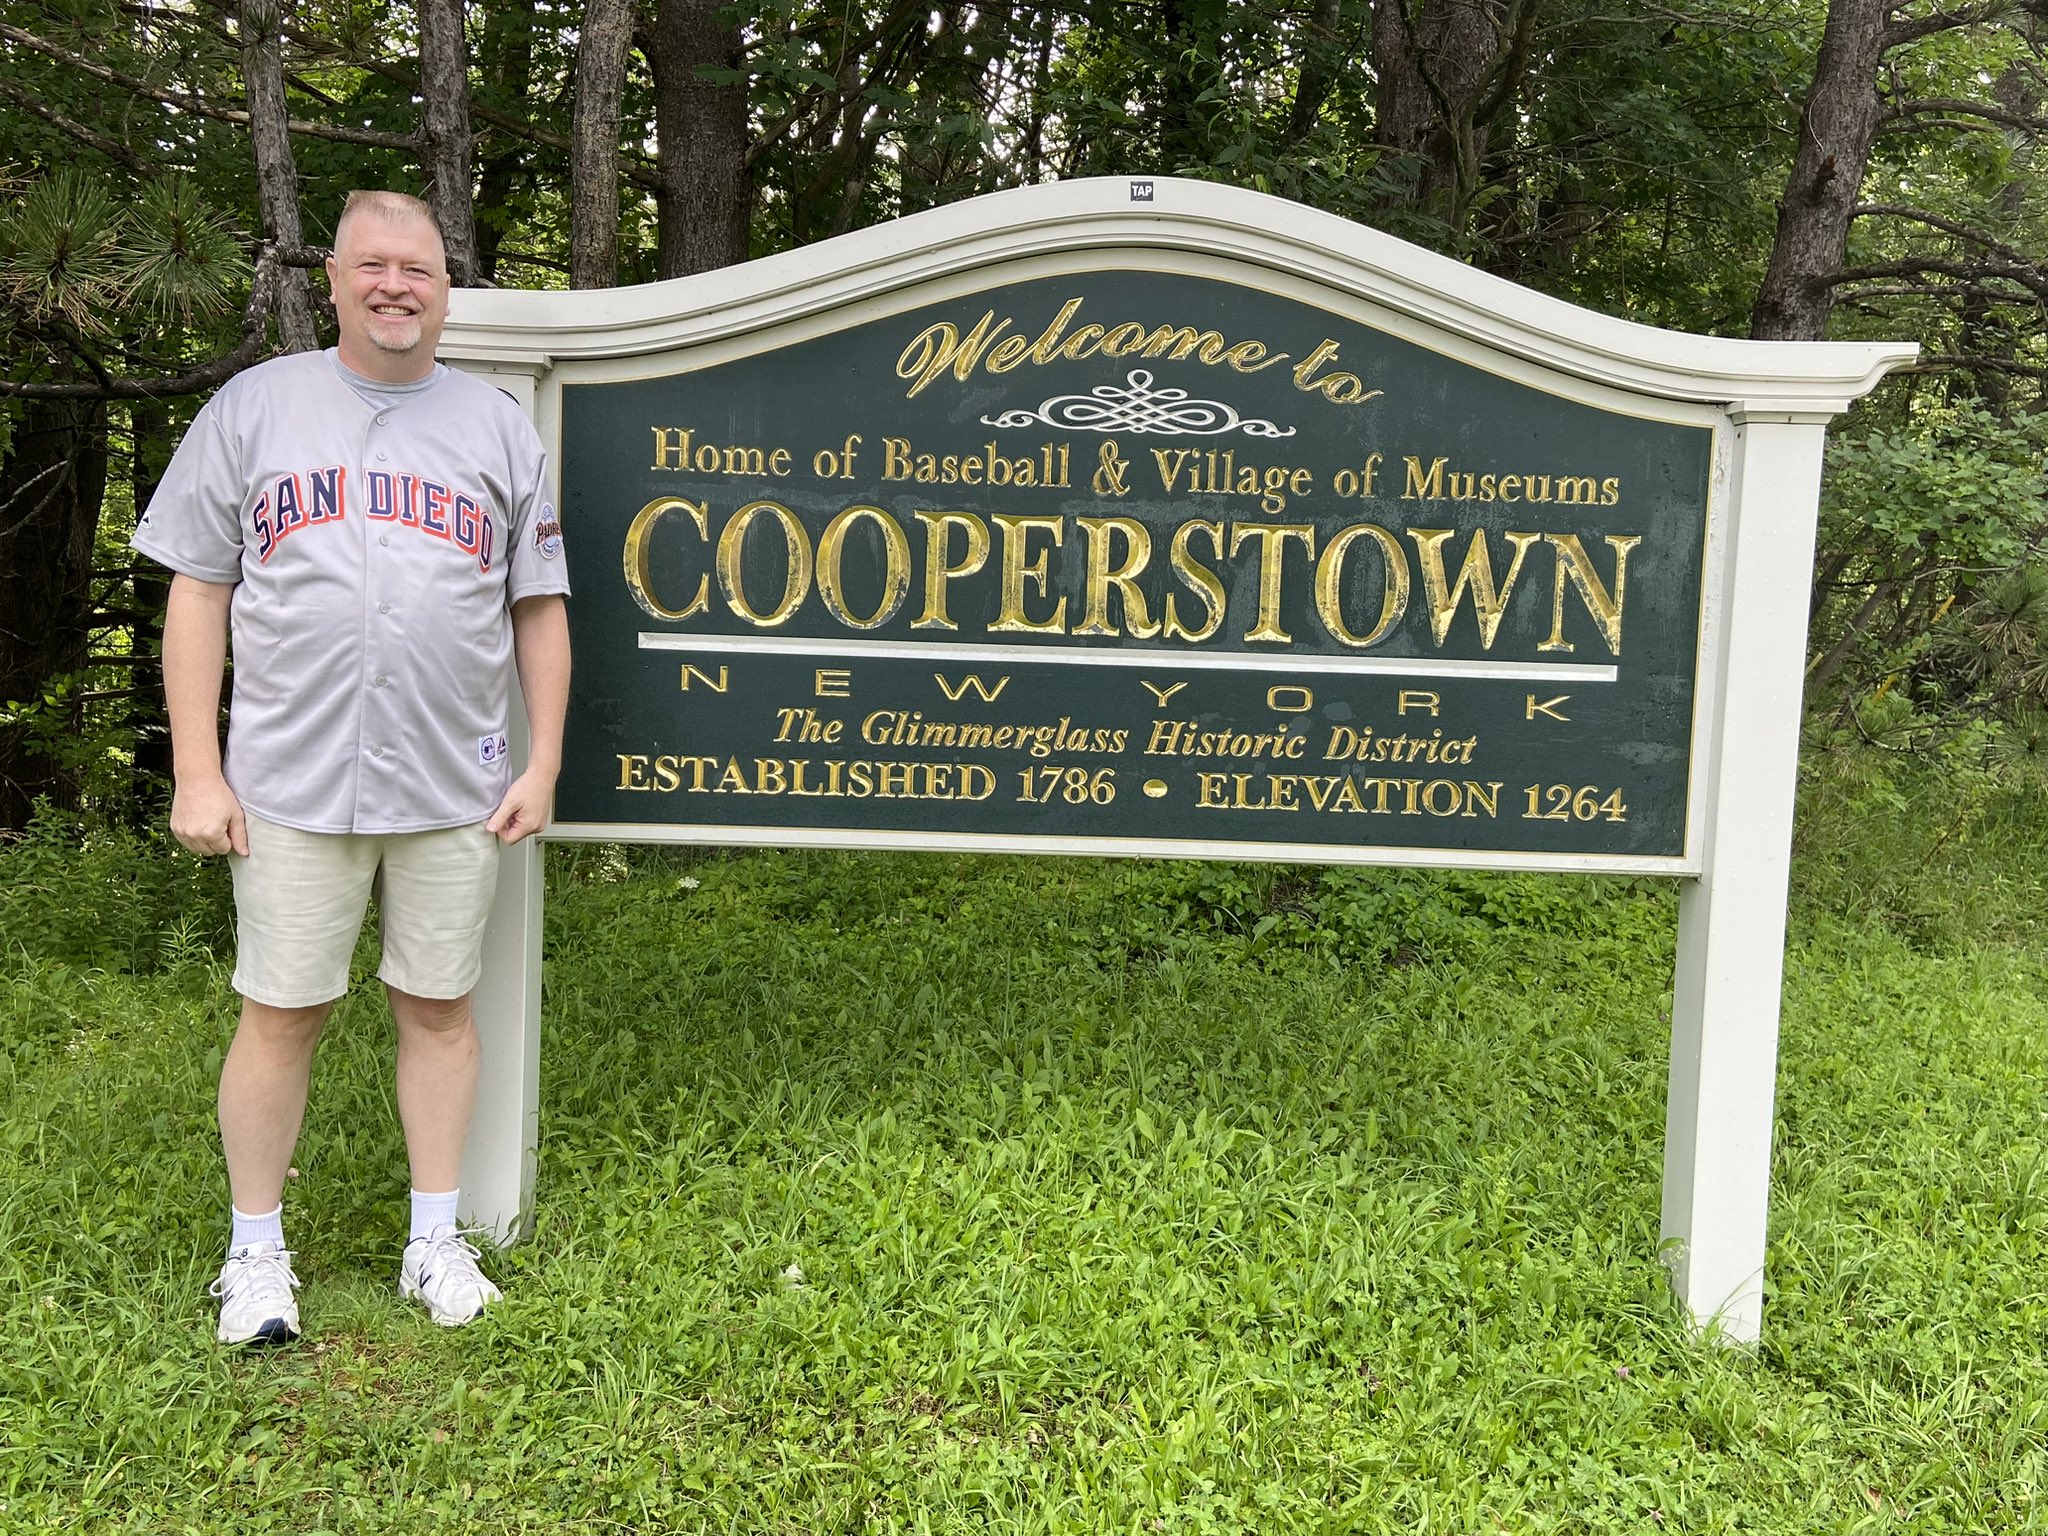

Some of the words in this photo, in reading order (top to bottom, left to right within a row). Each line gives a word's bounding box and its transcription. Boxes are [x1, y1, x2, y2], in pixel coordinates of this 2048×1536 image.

[1131, 185, 1153, 197] TAP
[896, 297, 1289, 399] Welcome
[1292, 337, 1384, 405] to
[650, 425, 792, 477] Home
[813, 433, 862, 480] of
[881, 436, 1071, 489] Baseball
[1091, 439, 1132, 497] &
[1151, 447, 1313, 515] Village
[1333, 452, 1383, 499] of
[1401, 456, 1621, 507] Museums
[252, 465, 346, 565] SAN
[364, 468, 493, 574] DIEGO
[622, 496, 1641, 656] COOPERSTOWN
[681, 664, 1010, 703] NEW
[1140, 680, 1571, 722] YORK
[773, 707, 843, 744] The
[861, 709, 1129, 757] Glimmerglass
[1144, 719, 1307, 759] Historic
[1325, 725, 1478, 765] District
[616, 754, 997, 802] ESTABLISHED
[1016, 766, 1116, 806] 1786
[1195, 772, 1504, 819] ELEVATION
[1523, 783, 1627, 823] 1264
